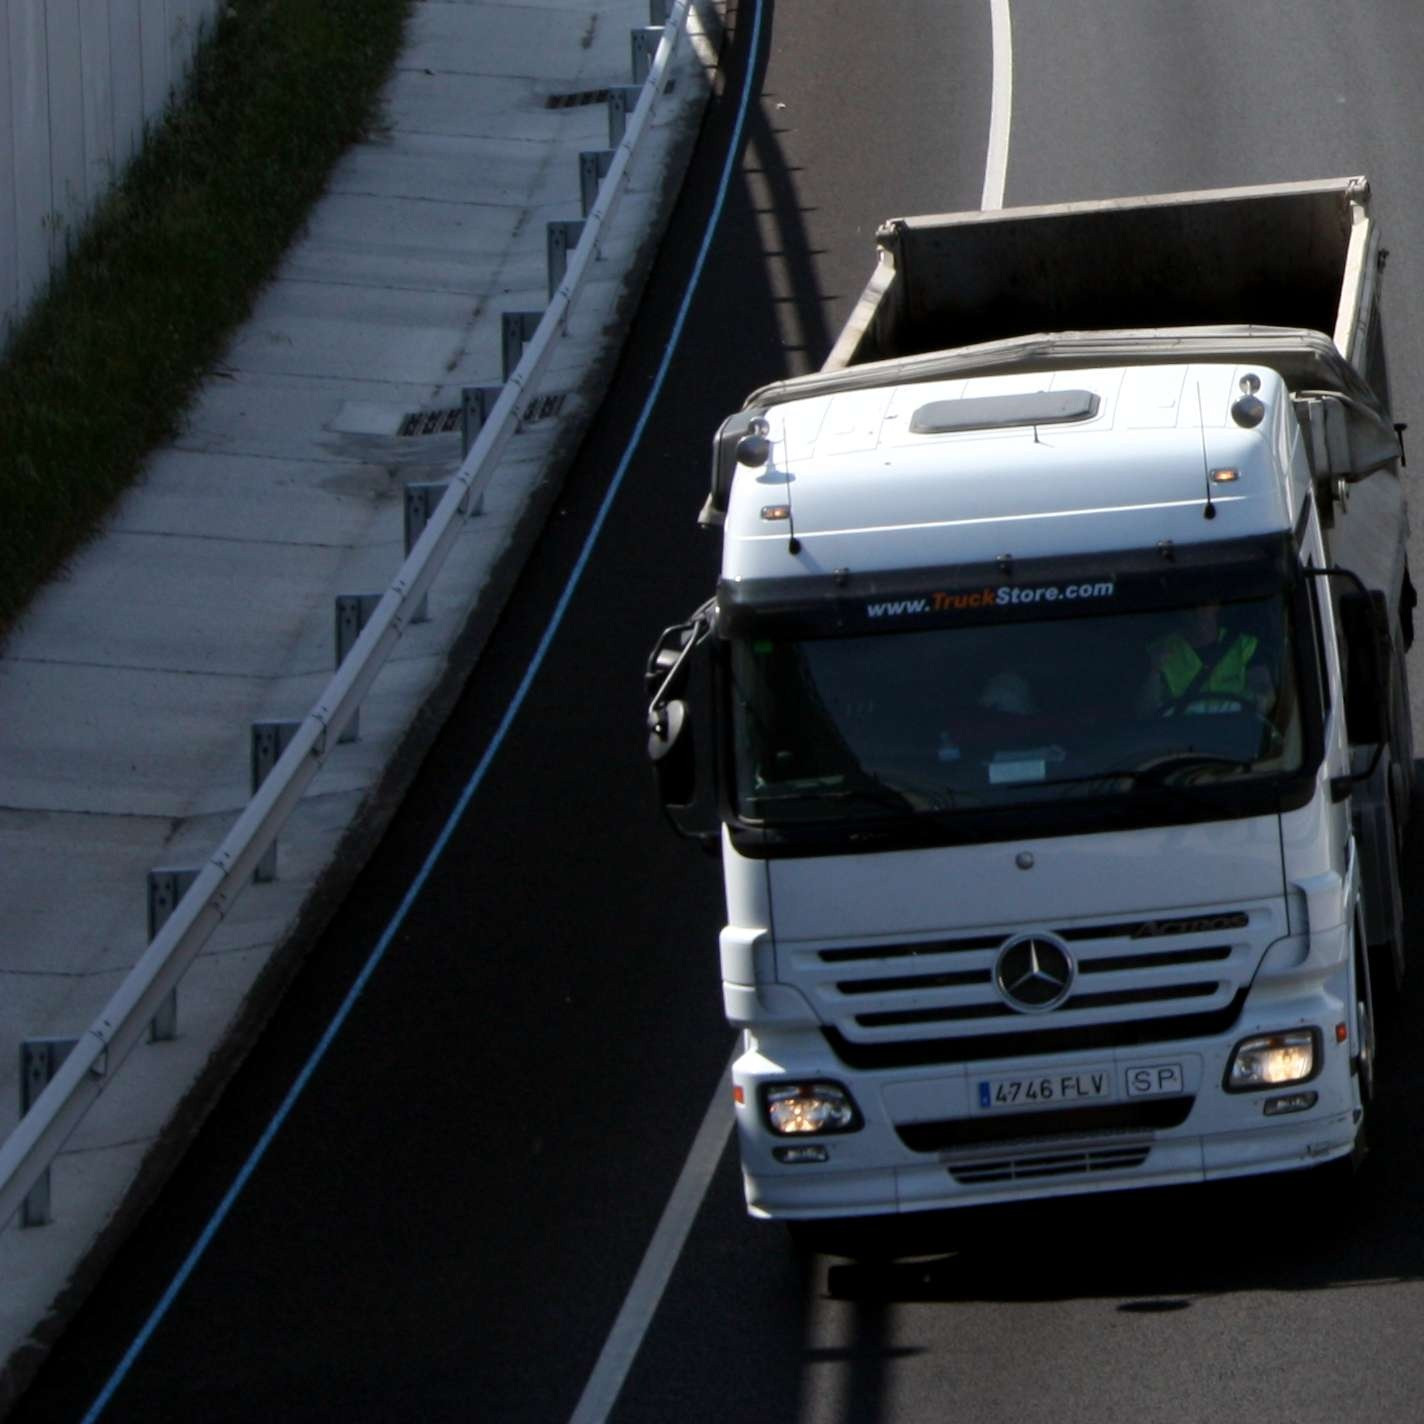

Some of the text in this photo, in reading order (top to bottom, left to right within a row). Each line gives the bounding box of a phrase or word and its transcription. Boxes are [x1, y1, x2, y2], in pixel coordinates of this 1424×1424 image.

[867, 582, 1114, 617] www.TruckStore.com
[995, 1074, 1104, 1103] 4746 FLV
